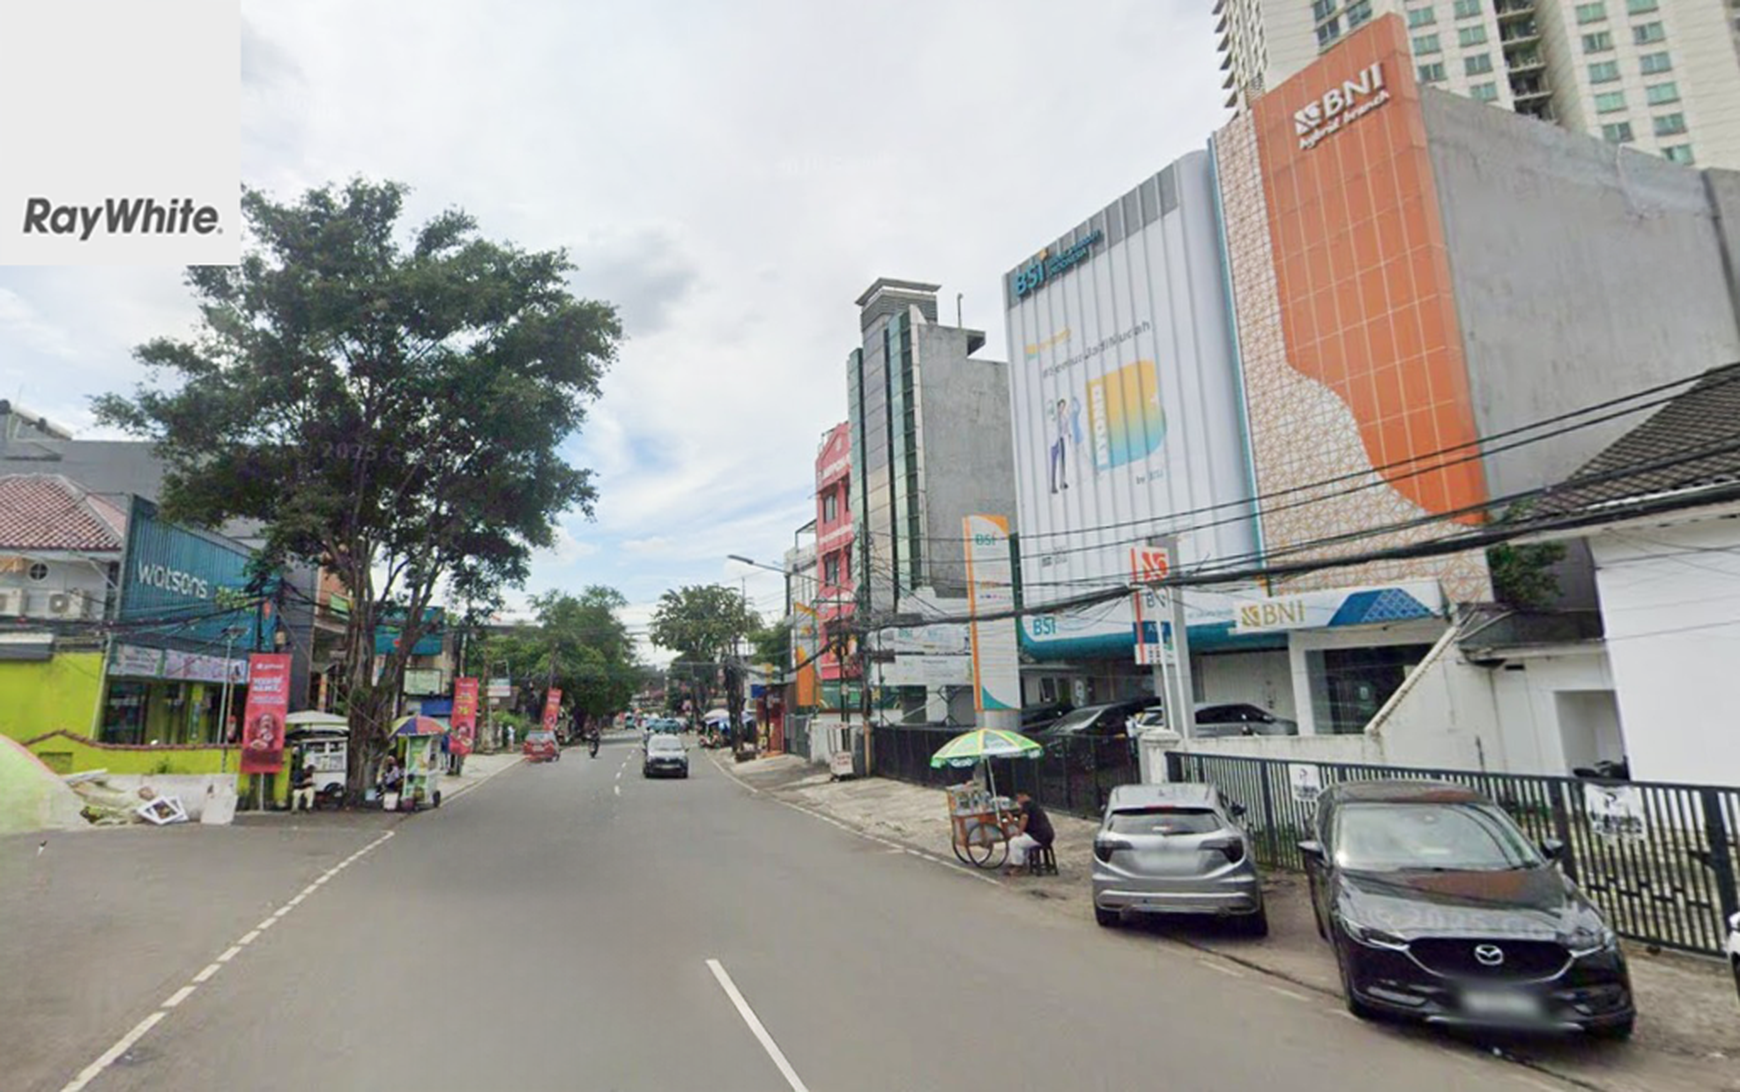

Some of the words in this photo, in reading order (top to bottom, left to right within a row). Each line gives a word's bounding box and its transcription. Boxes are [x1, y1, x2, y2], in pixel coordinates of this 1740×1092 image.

[1323, 62, 1383, 118] BNI
[1015, 257, 1044, 296] BSI
[975, 531, 996, 546] BSI
[138, 558, 209, 599] watsons
[1033, 616, 1057, 636] BSI
[1263, 599, 1305, 626] BNI
